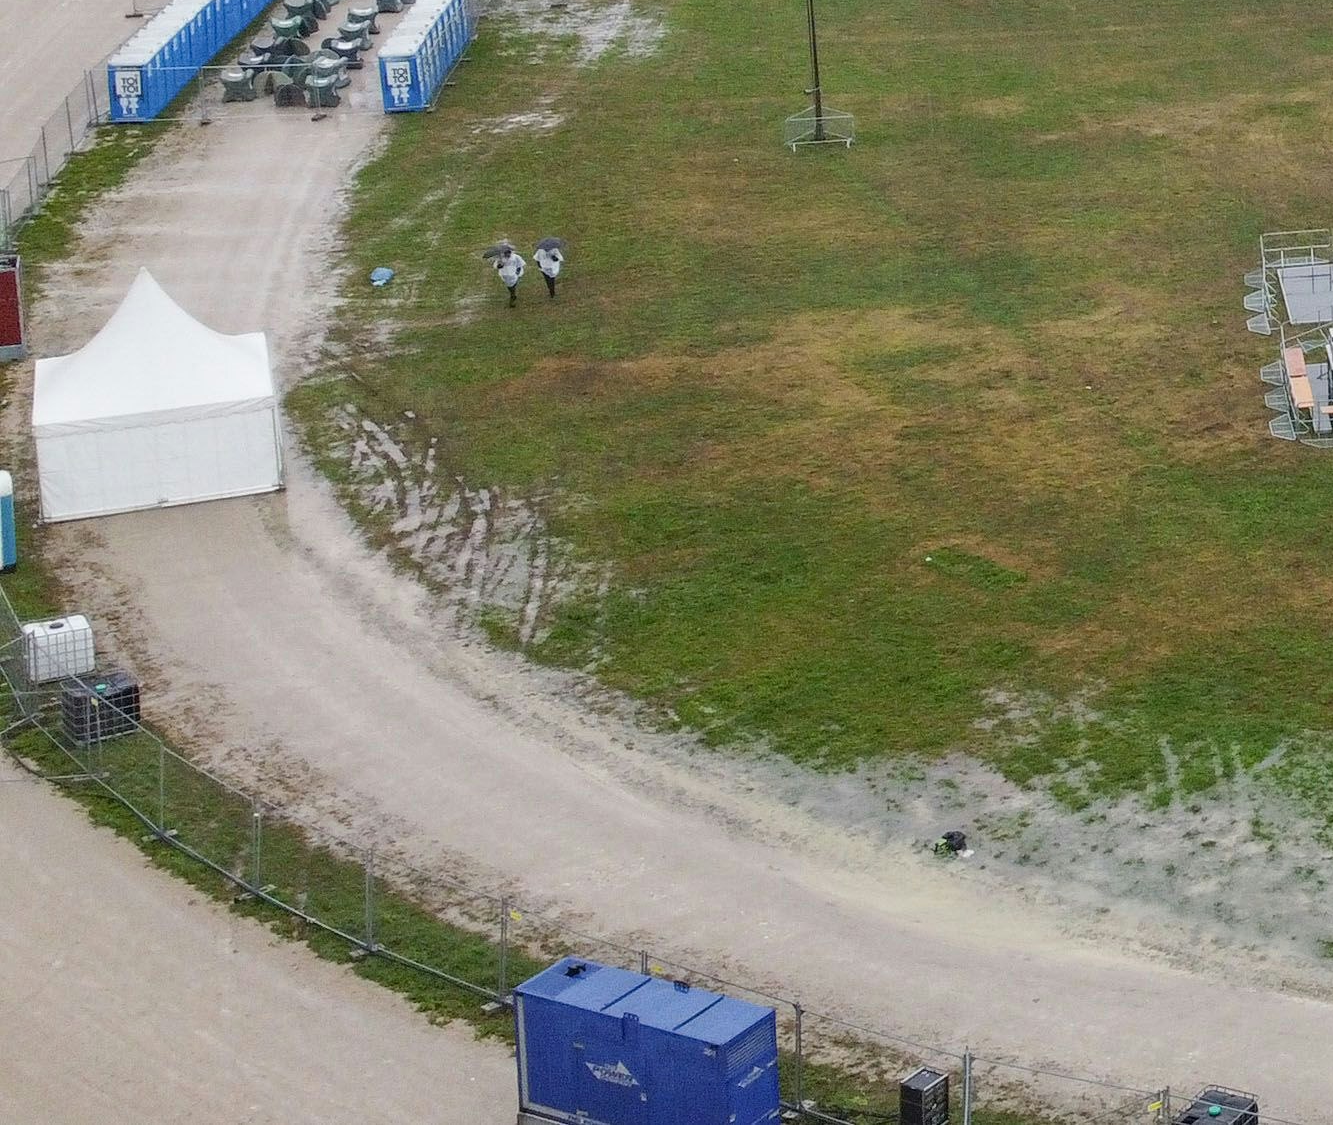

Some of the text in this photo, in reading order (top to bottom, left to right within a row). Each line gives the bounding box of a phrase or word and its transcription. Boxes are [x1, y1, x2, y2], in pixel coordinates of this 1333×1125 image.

[392, 67, 408, 75] TOI
[121, 77, 138, 85] TOI
[392, 75, 408, 83] TOI
[121, 85, 139, 93] TOI
